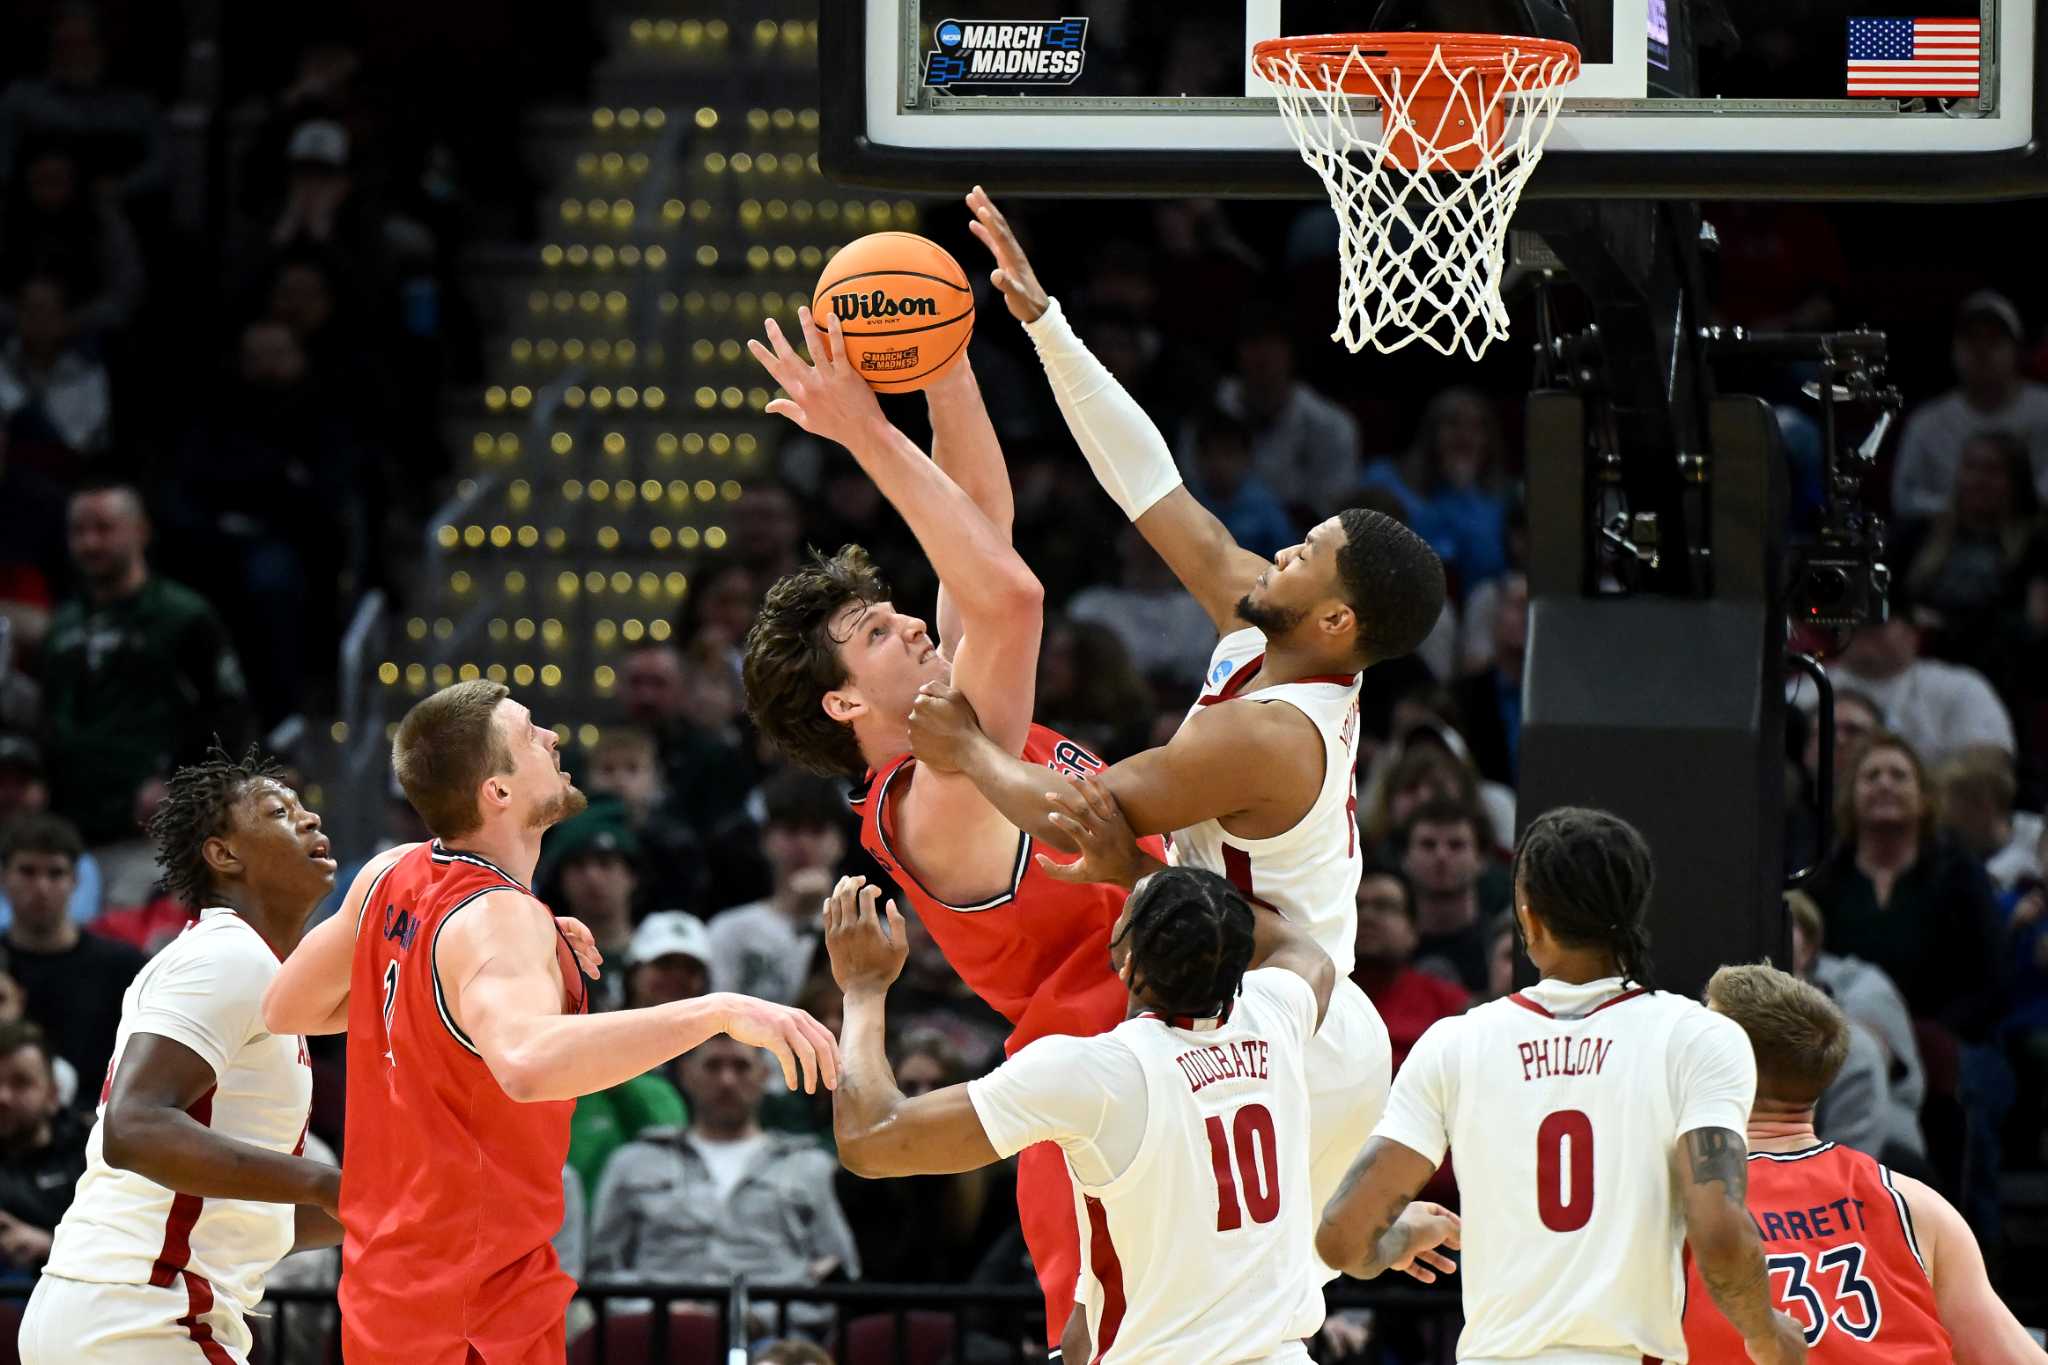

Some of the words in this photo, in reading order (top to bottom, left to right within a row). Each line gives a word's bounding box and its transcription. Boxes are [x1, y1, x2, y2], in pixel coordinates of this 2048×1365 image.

[962, 25, 1044, 49] MARCH
[971, 50, 1080, 74] MADNESS
[832, 290, 937, 321] Wilson
[871, 351, 903, 362] MARCH
[876, 357, 918, 369] MADNESS
[1517, 1036, 1613, 1081] PHILON
[1204, 1103, 1281, 1232] 10
[1537, 1109, 1594, 1233] 0
[1765, 1242, 1882, 1348] 33
